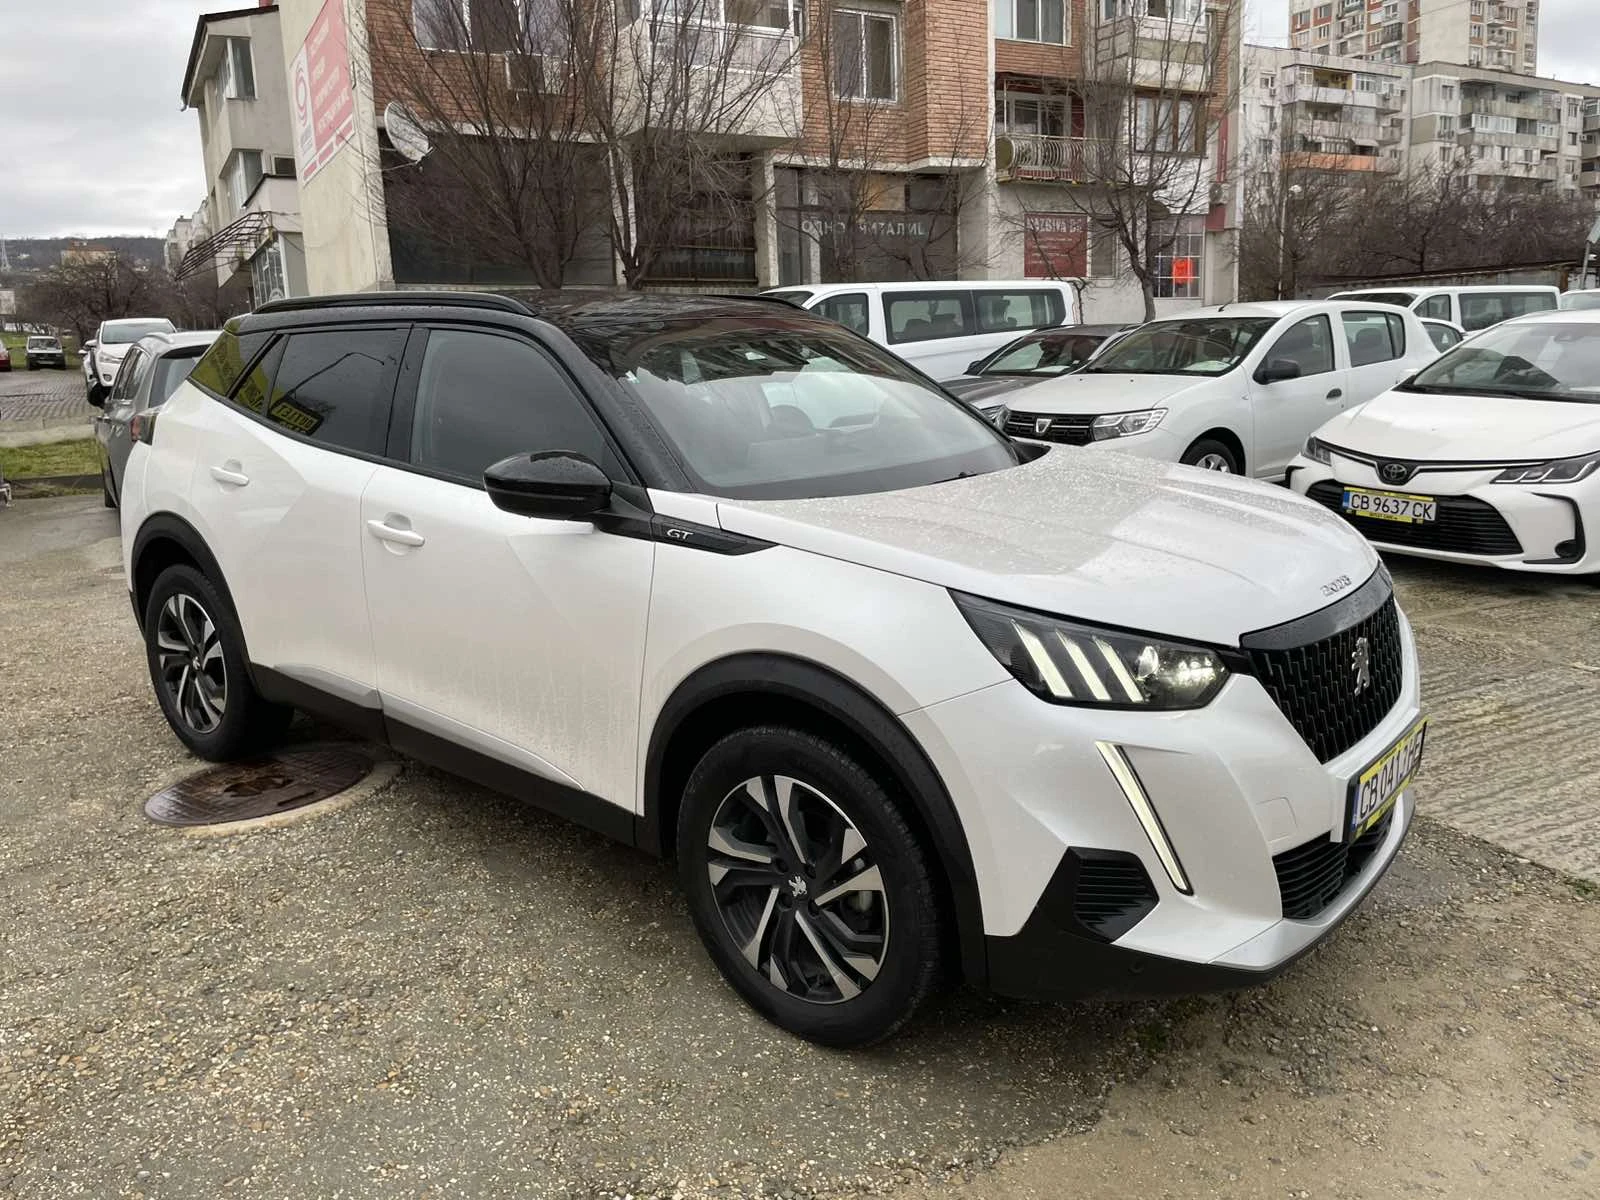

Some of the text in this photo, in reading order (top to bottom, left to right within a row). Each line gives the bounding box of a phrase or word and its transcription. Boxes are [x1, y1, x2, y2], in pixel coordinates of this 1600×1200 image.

[1351, 493, 1370, 510] CB
[1373, 497, 1409, 515] 9637
[1412, 502, 1433, 520] CK
[667, 529, 694, 539] GT
[1361, 772, 1379, 819] CB
